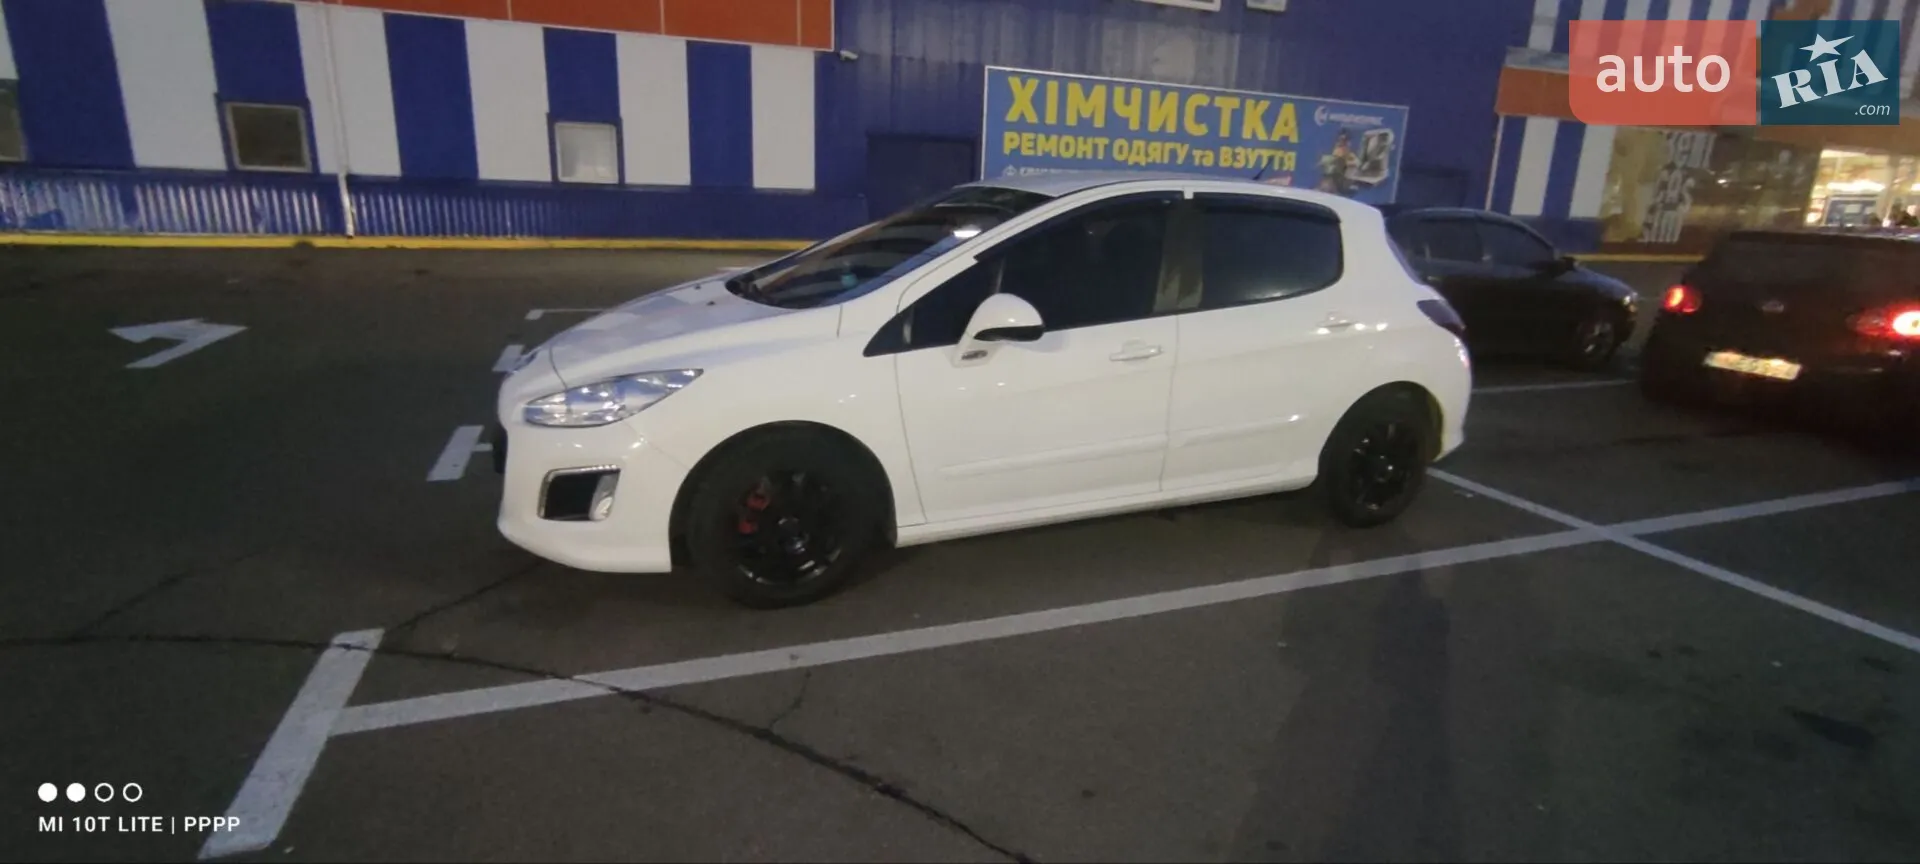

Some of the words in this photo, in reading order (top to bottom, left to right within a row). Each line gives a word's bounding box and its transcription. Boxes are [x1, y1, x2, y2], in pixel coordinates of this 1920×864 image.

[1005, 76, 1299, 143] ХІМЧИСТКА
[1003, 131, 1109, 160] РЕМОНТ
[1112, 138, 1189, 166] ОДЯГУ
[1192, 150, 1214, 167] та
[1218, 149, 1297, 172] ВЗУТТЯ
